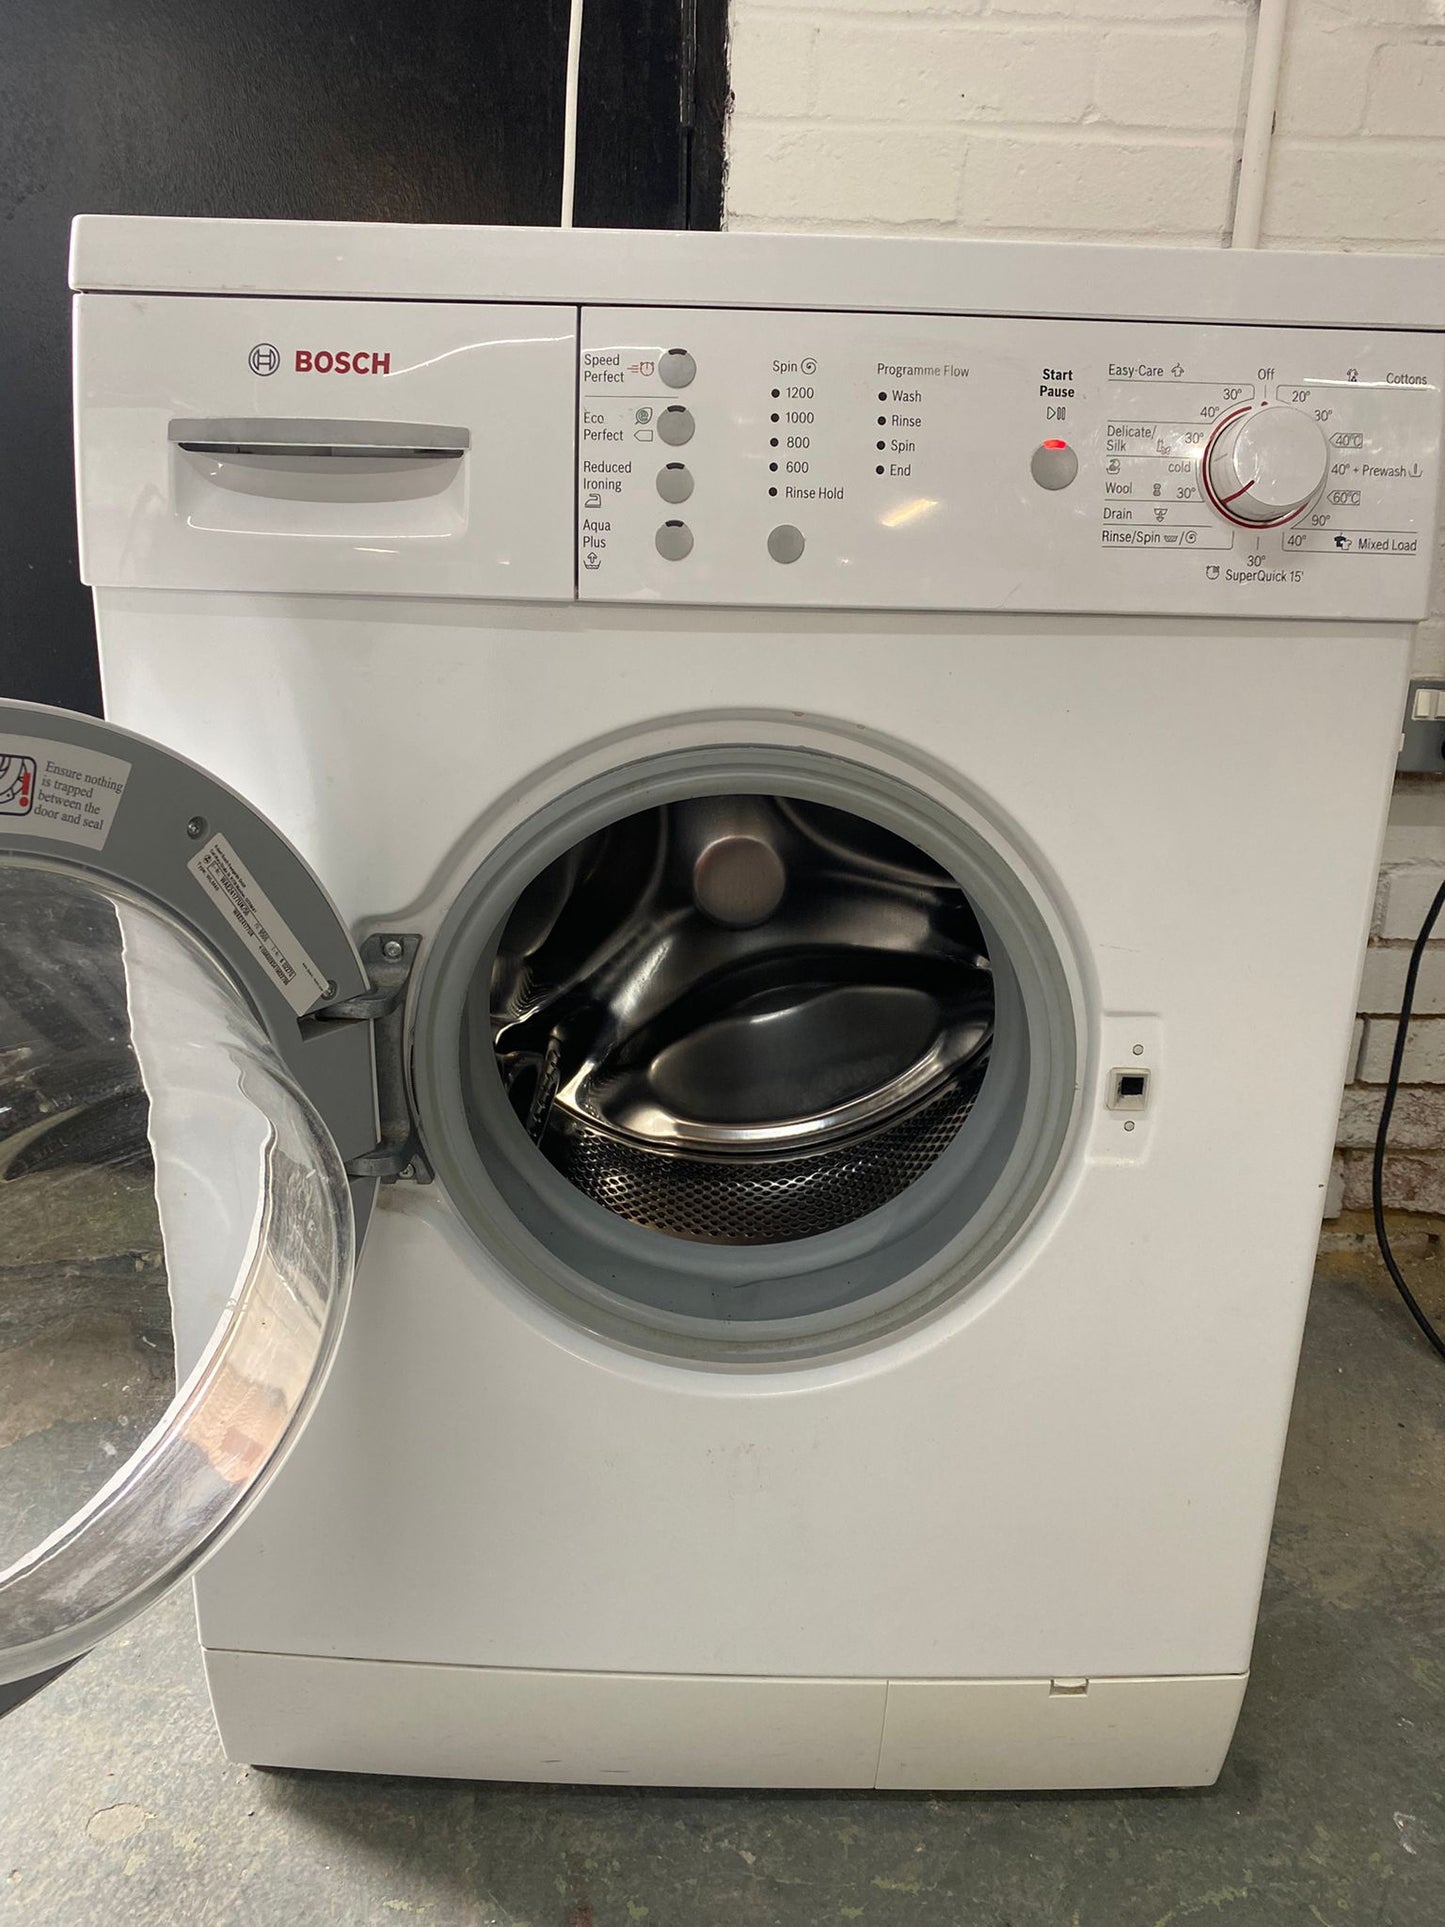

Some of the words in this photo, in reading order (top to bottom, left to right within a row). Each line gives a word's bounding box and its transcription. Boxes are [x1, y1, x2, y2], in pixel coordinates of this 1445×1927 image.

[295, 350, 391, 375] BOSCH
[584, 353, 620, 368] Speed
[772, 360, 798, 374] Spin
[584, 371, 624, 383] Perfect
[877, 363, 940, 378] Programme
[944, 365, 969, 377] Flow
[1042, 368, 1073, 381] Start
[1257, 368, 1275, 381] Off
[1386, 372, 1427, 385] Cottons
[785, 387, 815, 399] 1200
[892, 390, 922, 402] Wash
[1039, 385, 1075, 398] Pause
[1223, 388, 1243, 400] 30°
[1292, 390, 1311, 403] 20°
[583, 411, 605, 424] Eco
[785, 411, 815, 424] 1000
[1200, 406, 1220, 418] 40°
[1314, 409, 1333, 422] 30°
[891, 415, 922, 427] Rinse
[583, 429, 624, 441] Perfect
[1107, 425, 1157, 439] Delicate/
[1184, 432, 1204, 444] 30°
[786, 436, 811, 449] 800
[890, 439, 916, 454] Spin
[1106, 439, 1127, 452] Silk
[583, 461, 632, 473] Reduced
[786, 461, 809, 473] 600
[890, 464, 911, 477] End
[1168, 461, 1191, 473] cold
[1331, 463, 1350, 476] 40°
[1362, 464, 1406, 477] Prewash
[583, 477, 622, 493] Ironing
[1105, 482, 1132, 494] Wool
[785, 486, 816, 499] Rinse
[818, 487, 844, 500] Hold
[1176, 487, 1196, 499] 30°
[1103, 507, 1133, 520] Drain
[583, 519, 611, 533] Aqua
[1311, 514, 1331, 527] 90°
[583, 536, 606, 549] Plus
[1101, 530, 1161, 545] Rinse/Spin
[1287, 534, 1307, 547] 40°
[1358, 538, 1389, 551] Mixed
[1392, 539, 1417, 551] Load
[1246, 554, 1266, 567] 30°
[1225, 568, 1287, 583] SuperQuick
[45, 760, 82, 781] Ensure
[84, 774, 124, 794] nothing
[41, 774, 51, 787] is
[54, 780, 94, 798] trapped
[37, 789, 82, 810] between
[84, 802, 101, 815] the
[33, 804, 60, 819] door
[61, 814, 82, 825] and
[83, 819, 104, 831] seal
